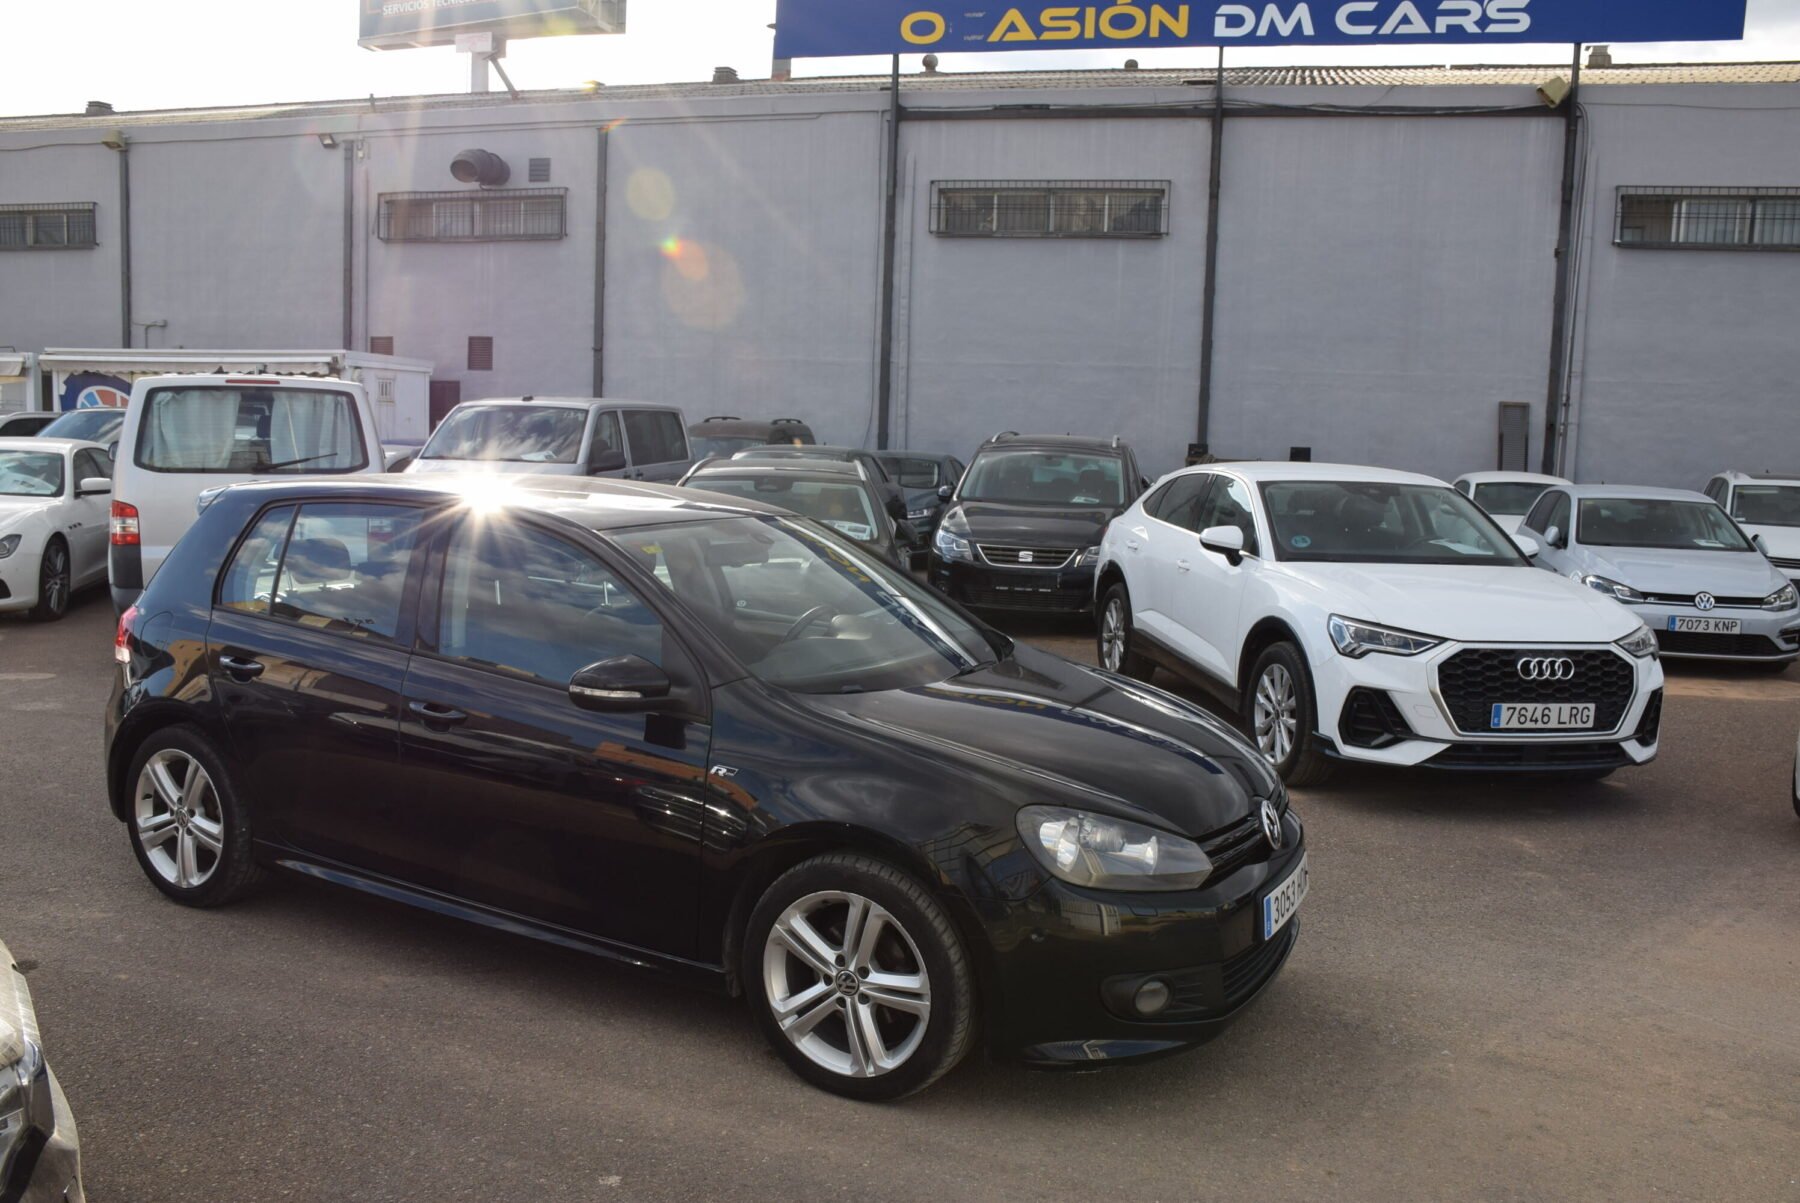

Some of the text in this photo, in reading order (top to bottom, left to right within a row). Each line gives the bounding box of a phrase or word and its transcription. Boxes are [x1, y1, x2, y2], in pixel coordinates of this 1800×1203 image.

[382, 1, 429, 16] SERVICIOS
[1214, 2, 1315, 37] DM
[1678, 619, 1738, 632] 7073 KNP
[1506, 706, 1552, 725] 7646
[1558, 706, 1591, 725] LRG
[1274, 879, 1296, 924] 3053
